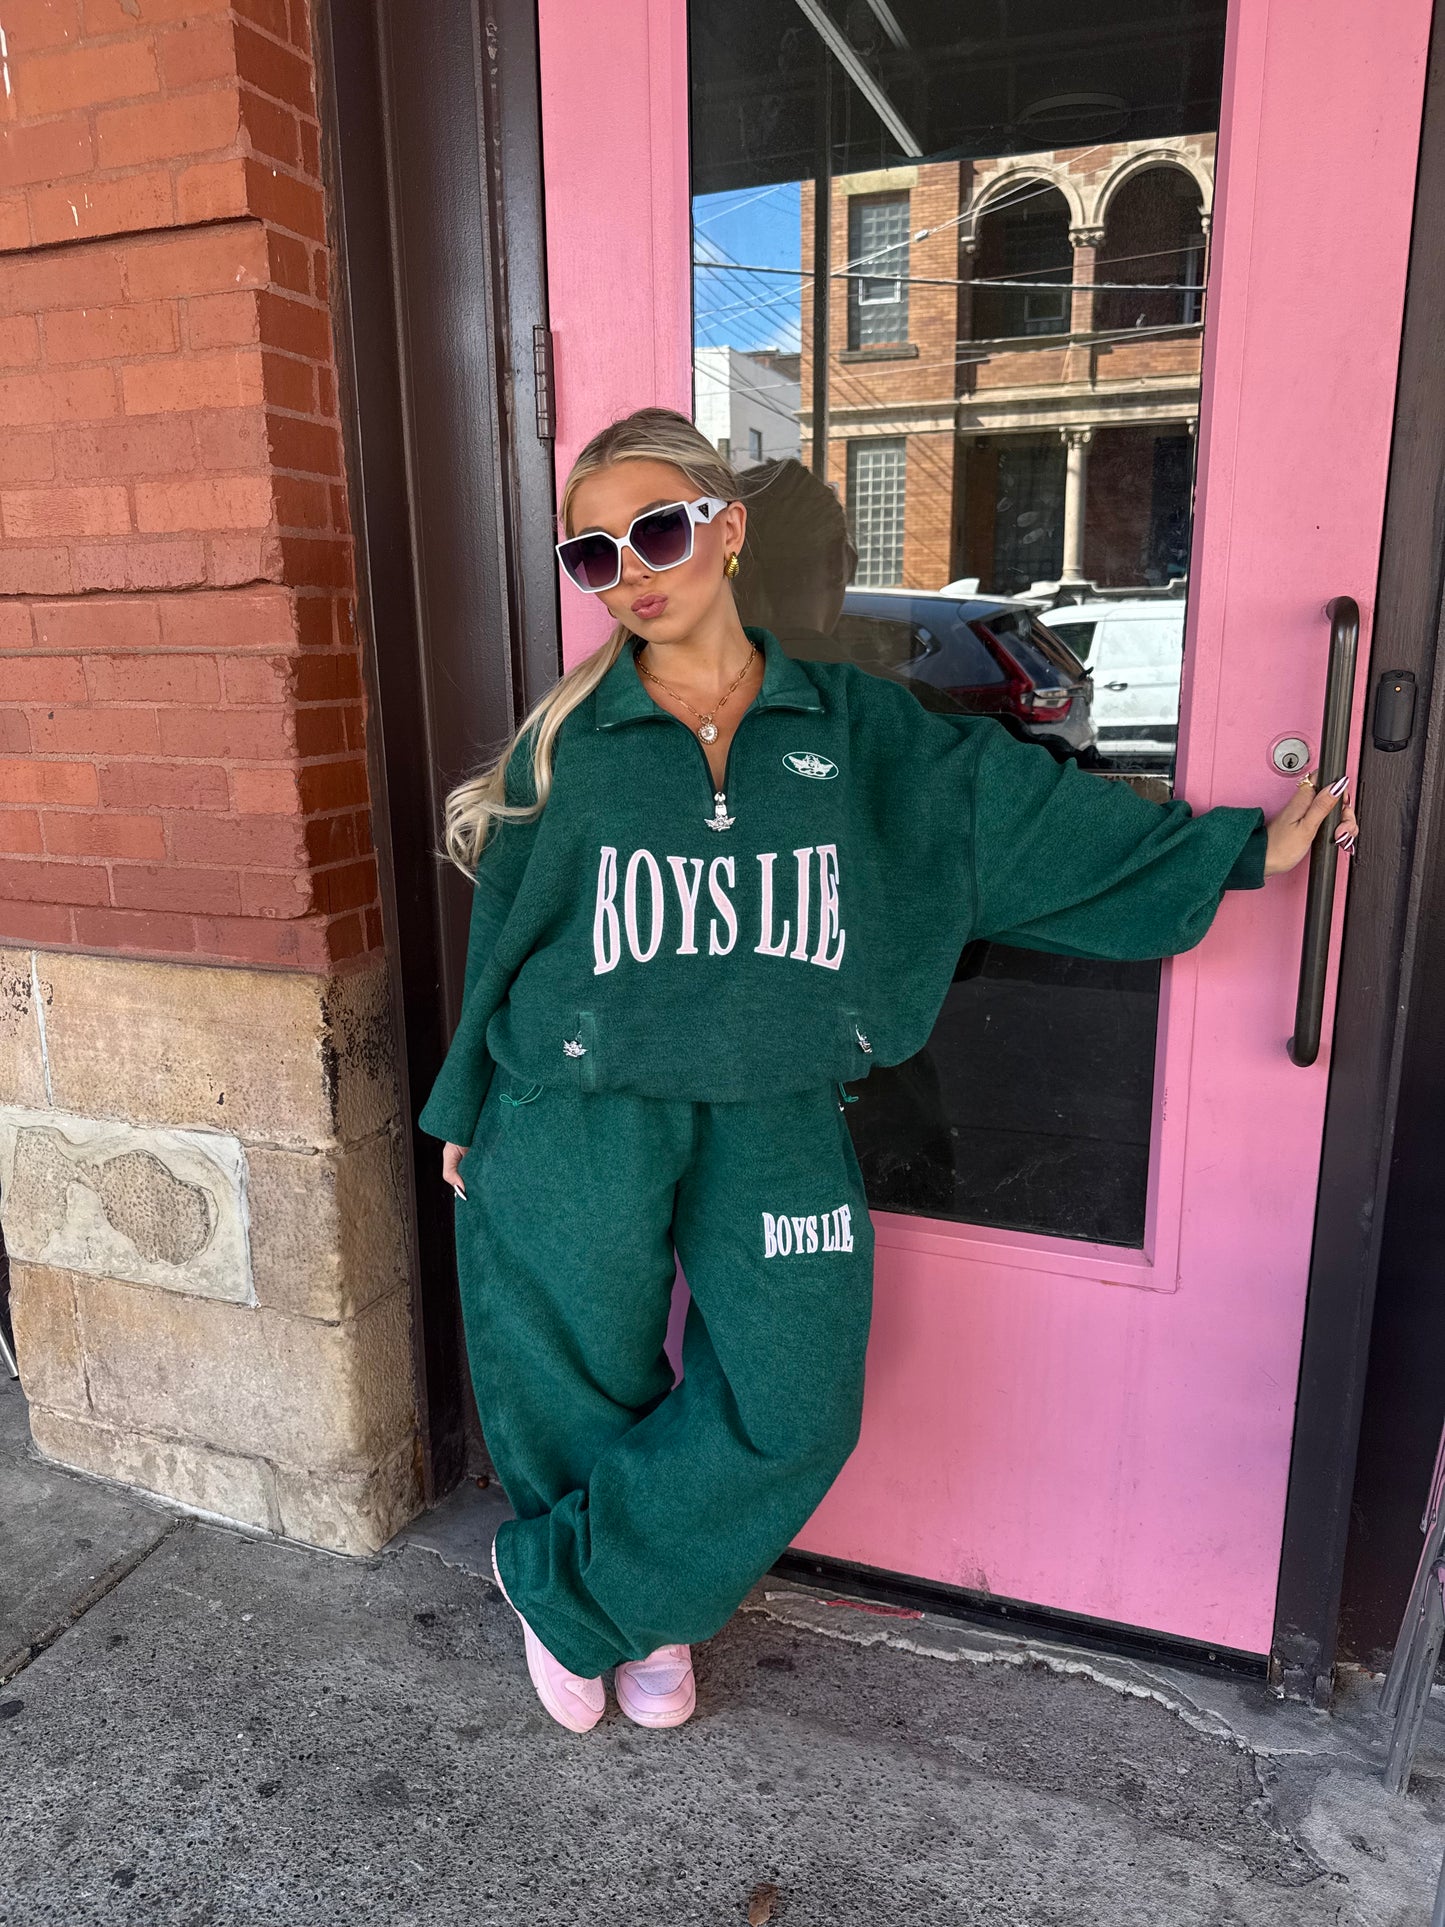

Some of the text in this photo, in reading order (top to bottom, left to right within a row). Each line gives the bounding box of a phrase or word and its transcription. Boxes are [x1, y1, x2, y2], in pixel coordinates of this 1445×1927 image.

[593, 844, 845, 975] BOYS LIE
[762, 1204, 853, 1258] BOYS LIE
